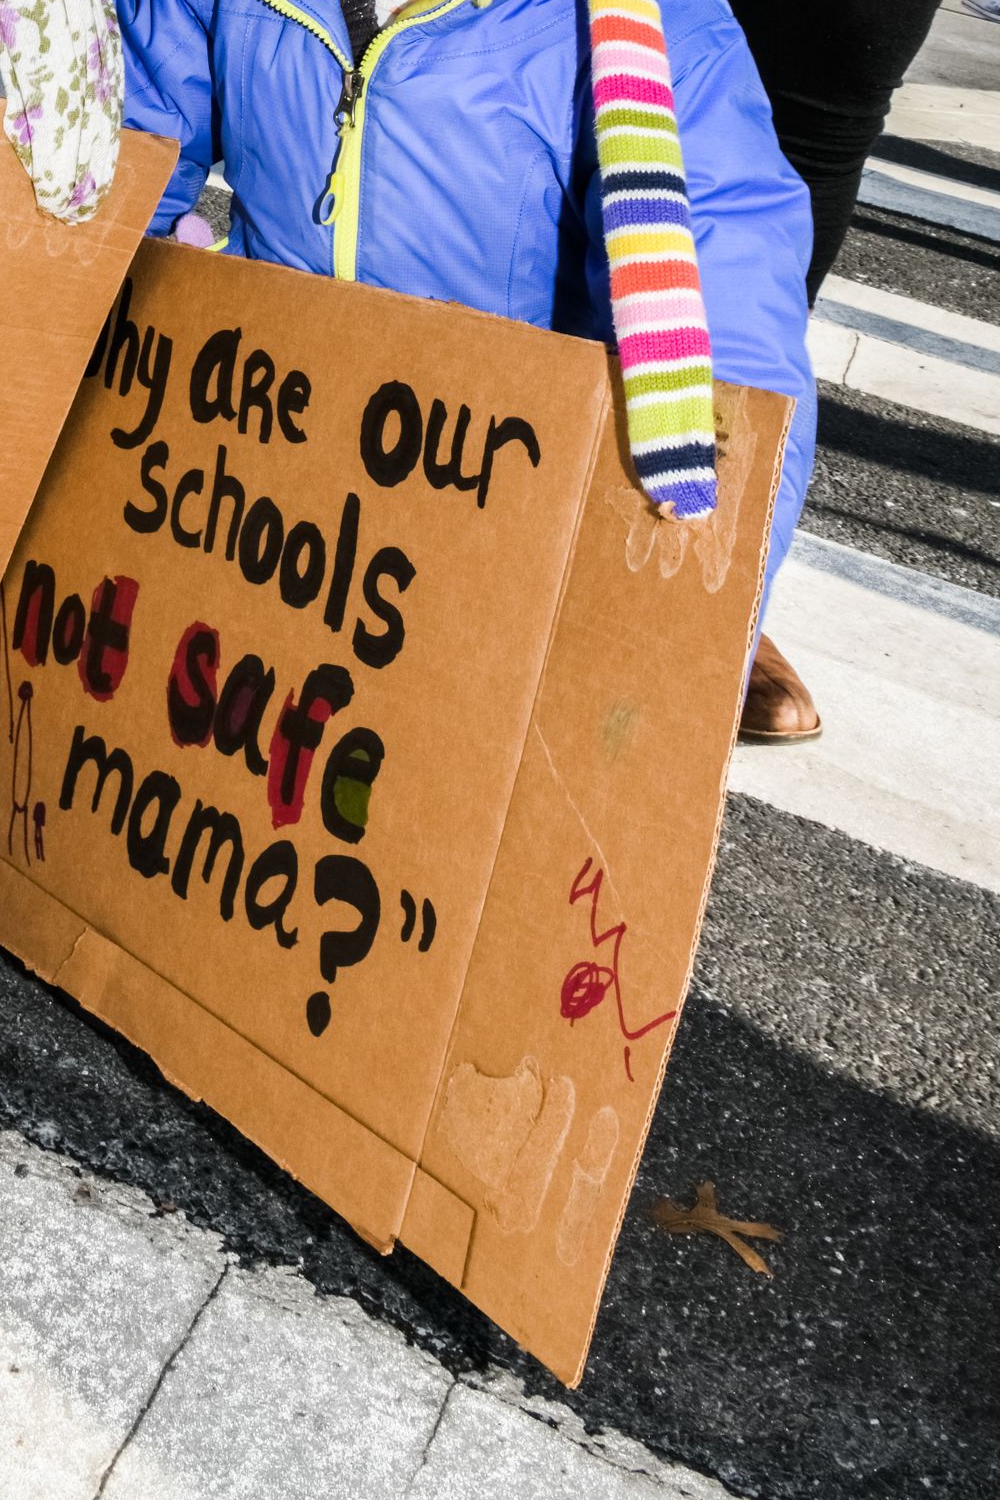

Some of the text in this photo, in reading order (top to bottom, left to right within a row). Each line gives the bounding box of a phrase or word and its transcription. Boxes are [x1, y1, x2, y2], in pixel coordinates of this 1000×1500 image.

[83, 277, 173, 449] hy
[12, 560, 385, 844] not safe
